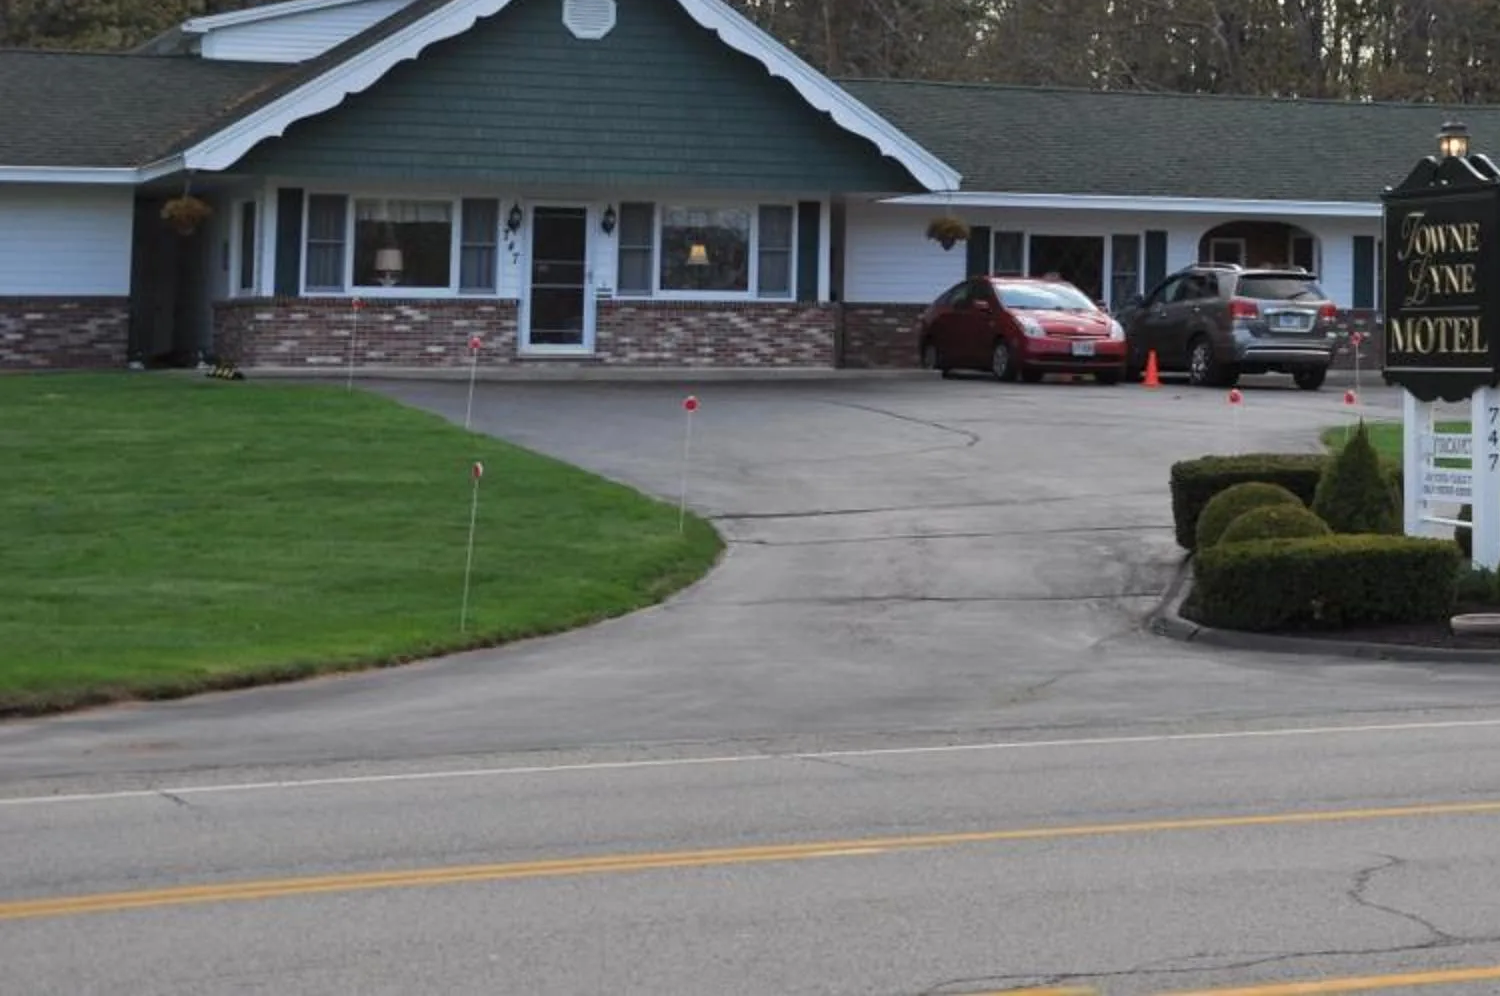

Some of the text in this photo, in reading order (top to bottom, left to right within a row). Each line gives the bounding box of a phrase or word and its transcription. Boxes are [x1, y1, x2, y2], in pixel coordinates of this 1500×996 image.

[1398, 212, 1480, 259] TOWNE
[1405, 253, 1476, 305] LYNE
[1390, 316, 1489, 354] MOTEL
